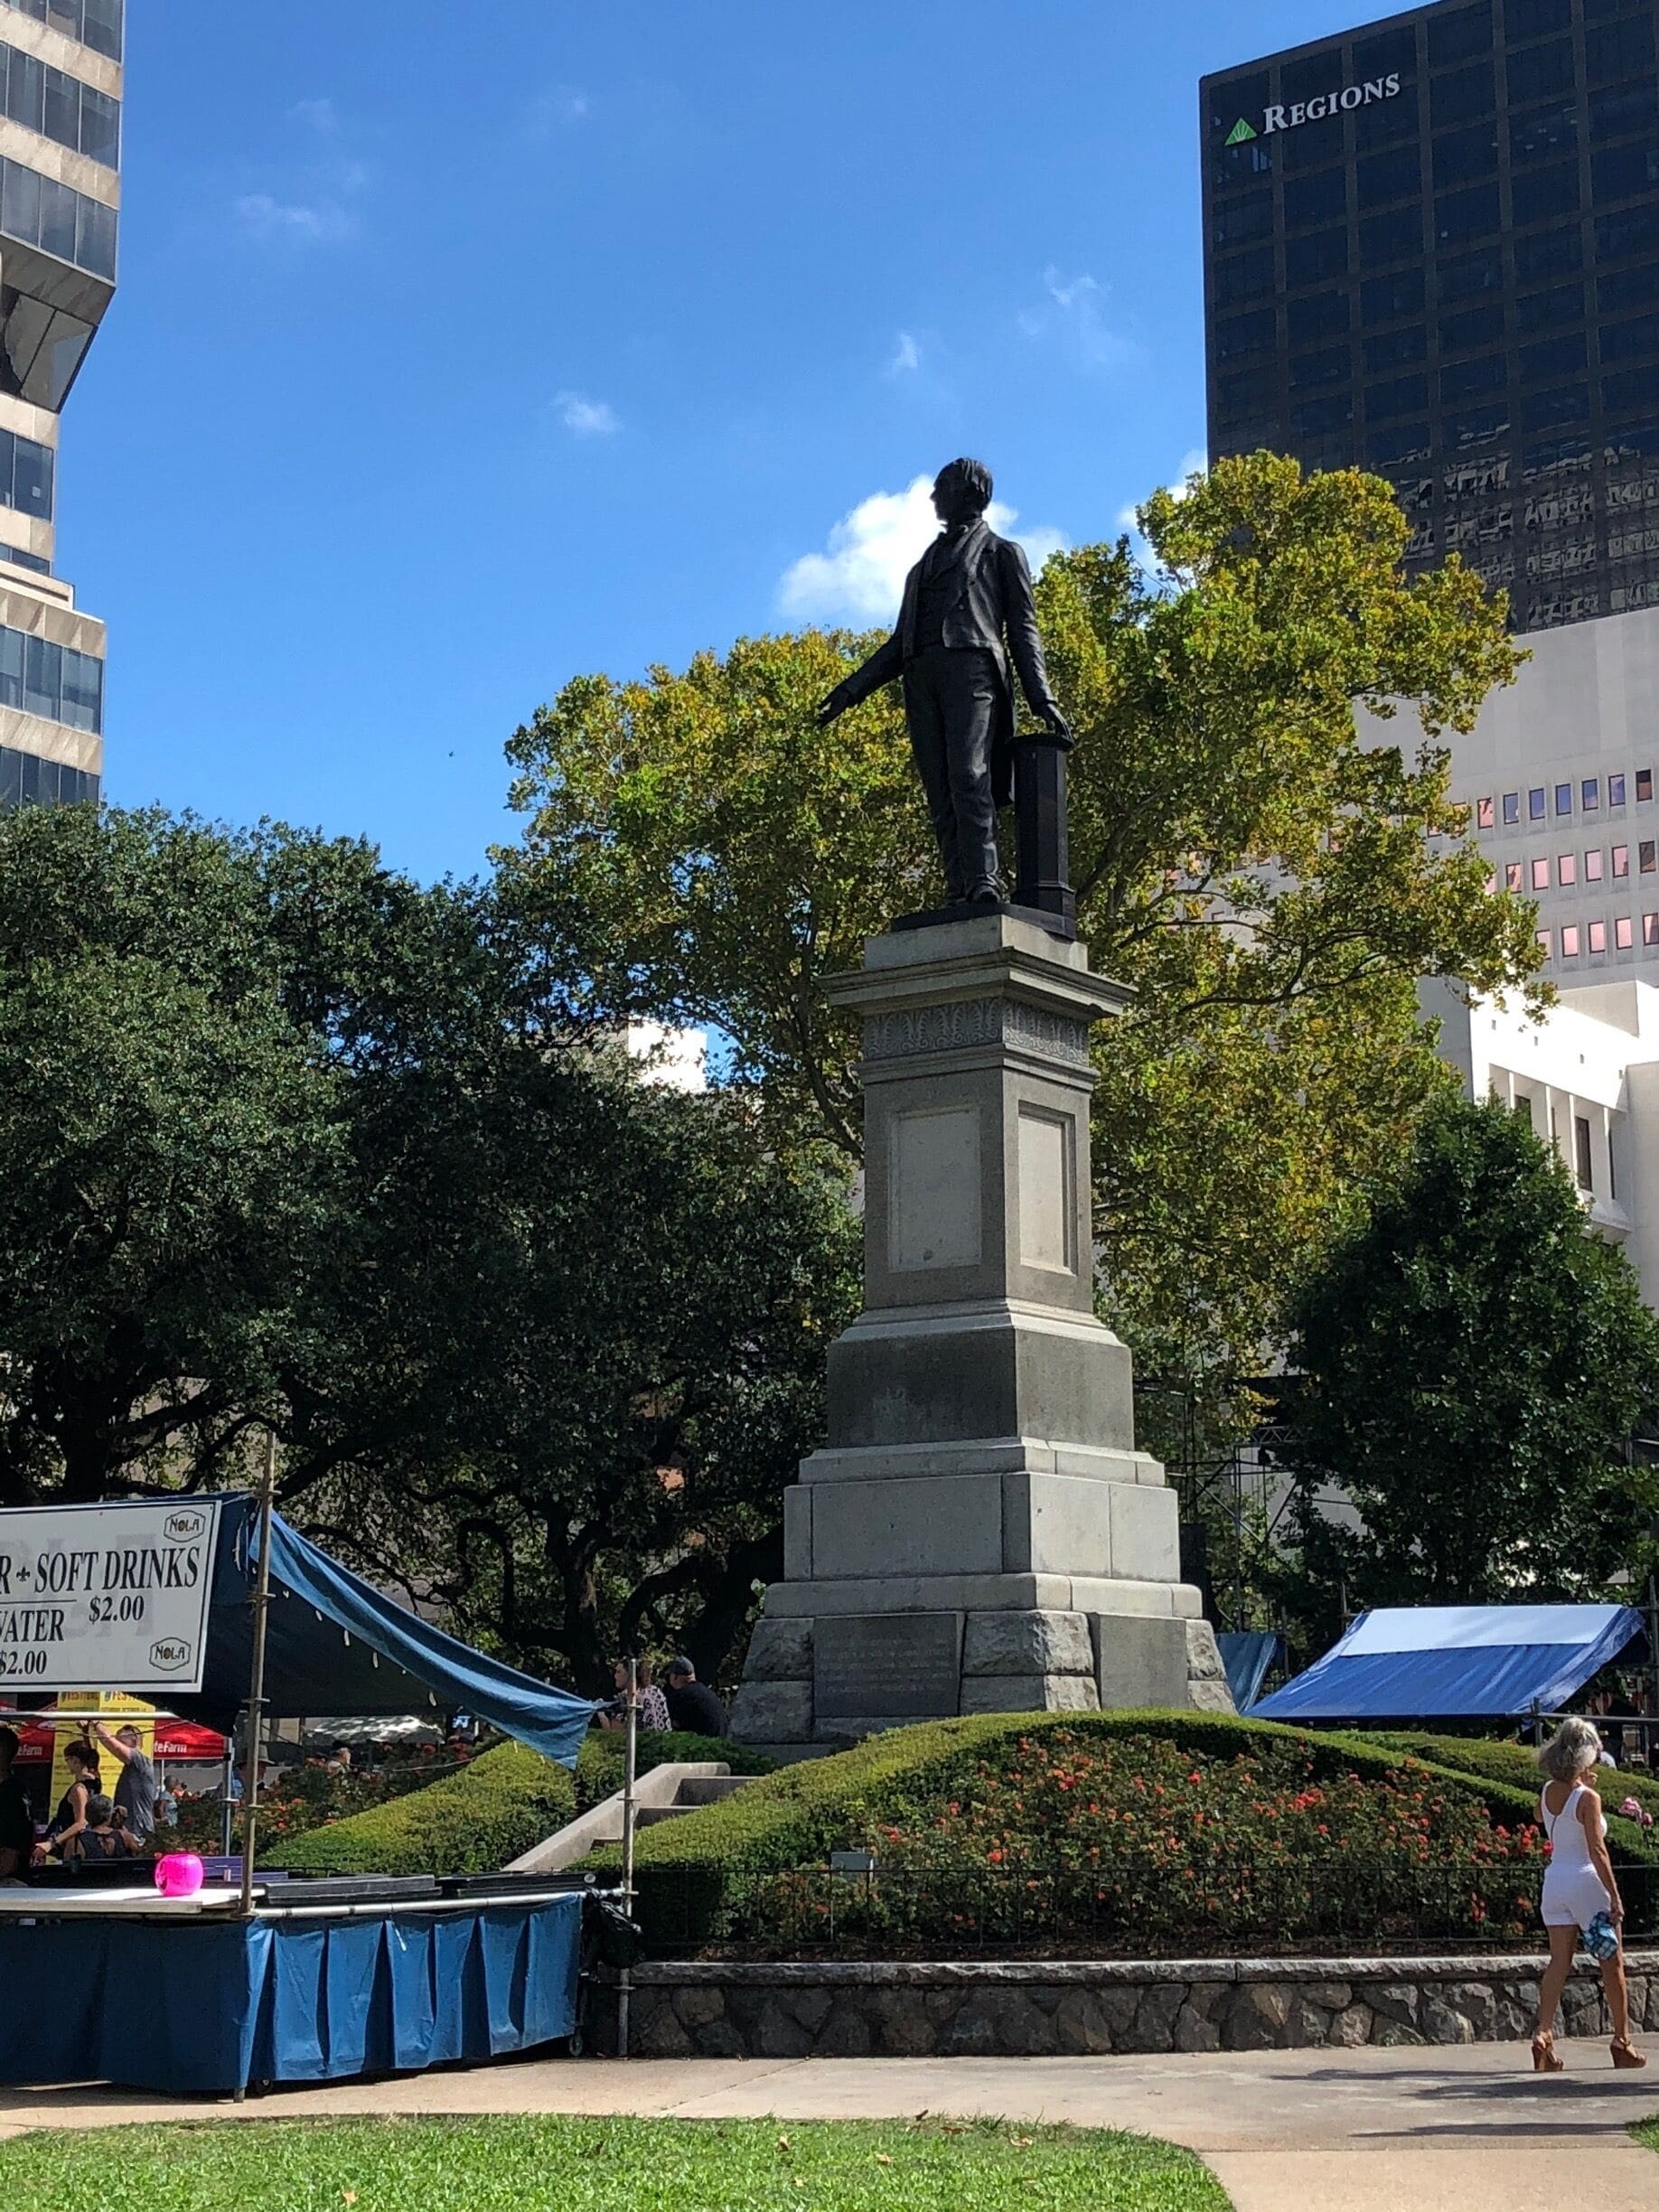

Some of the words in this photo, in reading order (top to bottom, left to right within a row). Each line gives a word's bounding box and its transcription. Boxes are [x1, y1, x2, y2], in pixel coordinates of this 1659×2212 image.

[1262, 73, 1400, 134] REGIONS
[169, 1518, 200, 1532] NOLA
[34, 1551, 98, 1593] SOFT
[102, 1547, 200, 1589] DRINKS
[89, 1595, 145, 1625] $2.00
[154, 1645, 184, 1659] NOLA
